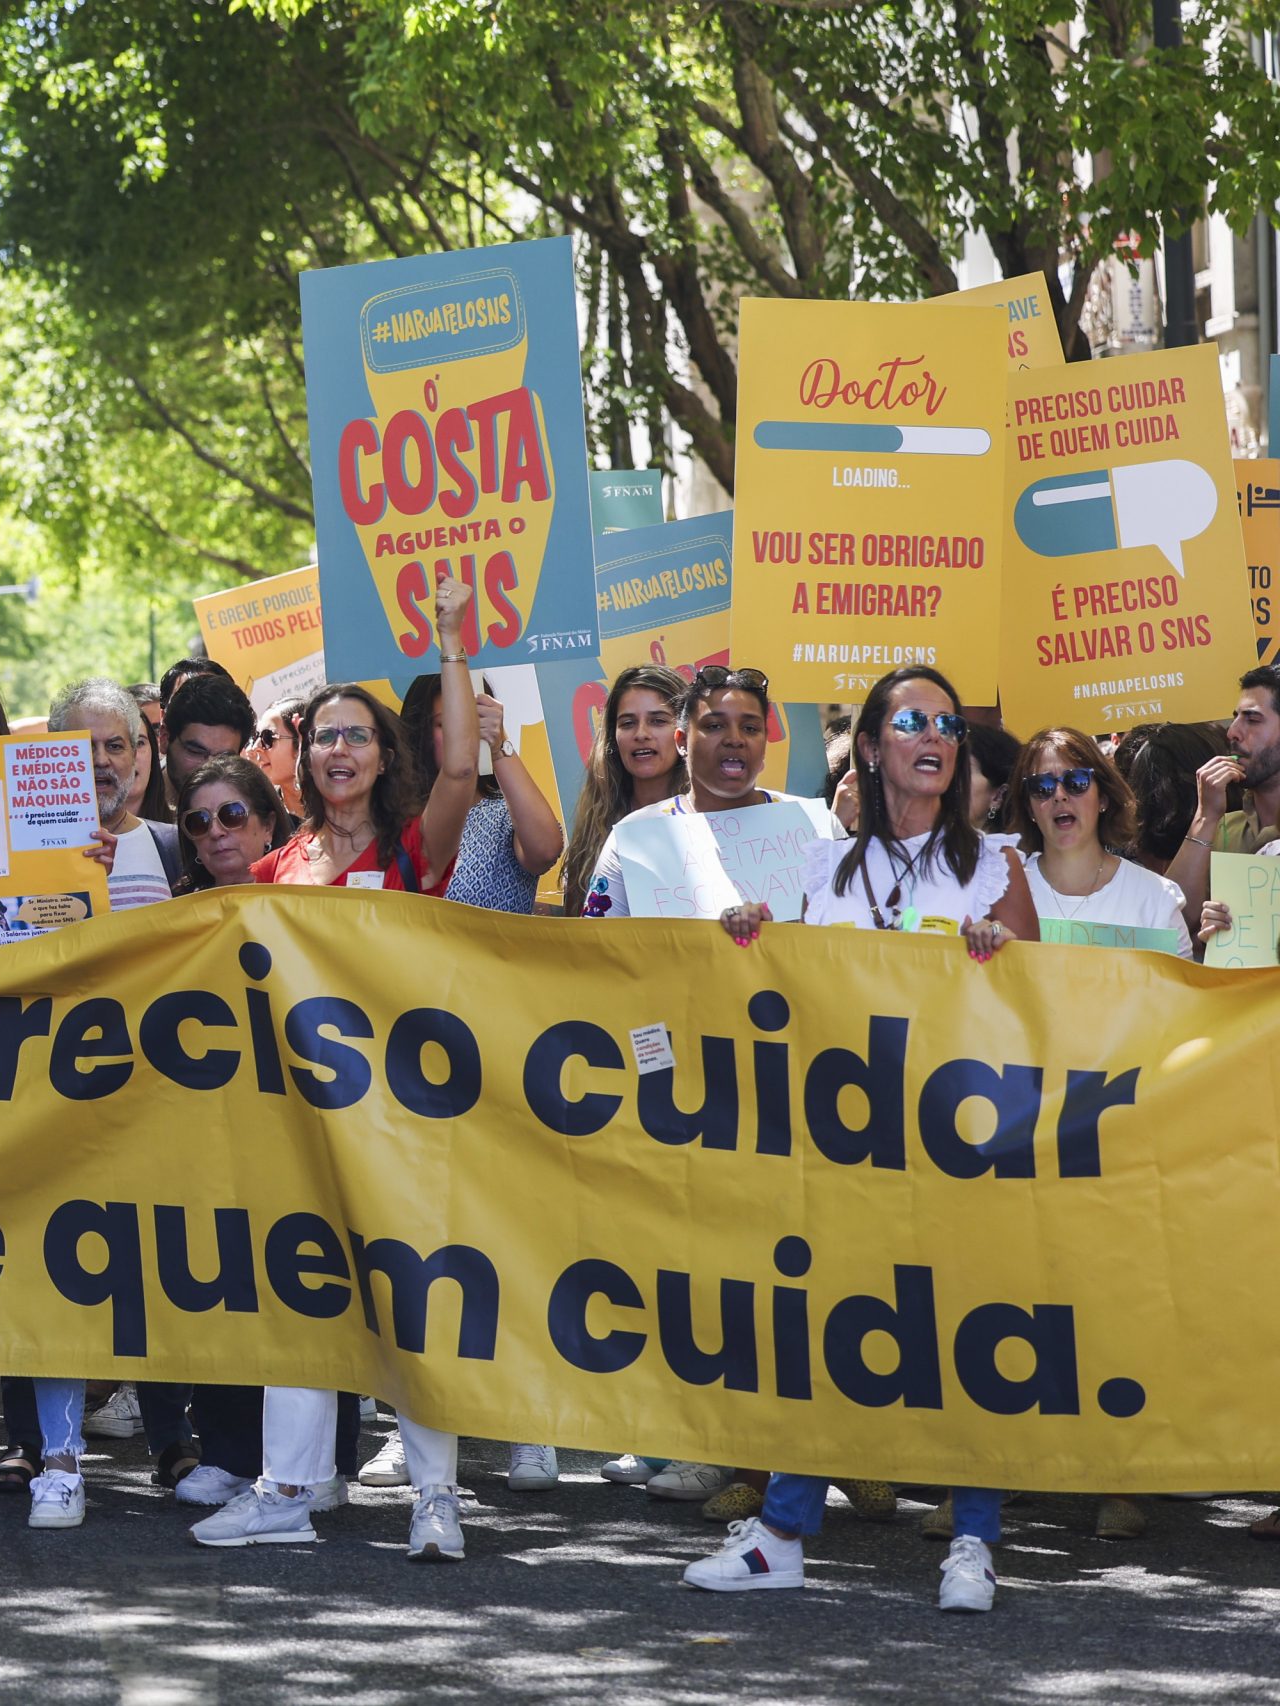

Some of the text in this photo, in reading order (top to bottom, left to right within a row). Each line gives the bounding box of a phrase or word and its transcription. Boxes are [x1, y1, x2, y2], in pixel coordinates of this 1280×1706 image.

[371, 293, 511, 344] #NARUAPELOSNS
[1008, 296, 1042, 323] AVE
[799, 354, 947, 416] Doctor
[1014, 378, 1186, 426] PRECISO CUIDAR
[1017, 414, 1180, 461] DE QUEM CUIDA
[338, 386, 553, 526] COSTA
[614, 487, 653, 497] FNAM
[832, 466, 910, 489] LOADING...
[375, 517, 526, 558] AGUENTA O
[752, 531, 985, 570] VOU SER OBRIGADO
[598, 558, 728, 612] #NARUAPELOSNS
[792, 582, 942, 617] A EMIGRAR?
[1052, 575, 1178, 621] É PRECISO
[206, 584, 315, 630] É GREVE PORQUE
[232, 618, 286, 650] TODOS
[542, 634, 592, 650] FNAM
[1036, 614, 1212, 667] SALVAR O SNS
[792, 643, 937, 665] #NARUAPELOSNS
[279, 664, 312, 685] preciso
[1074, 672, 1184, 699] #NARUAPELOSNS
[1116, 703, 1162, 718] FNAM
[12, 760, 86, 776] E MÉDICAS
[16, 744, 80, 760] MÉDICOS
[17, 775, 80, 791] NÃO SÃO
[12, 792, 91, 808] MÁQUINAS
[30, 811, 55, 820] preciso
[522, 990, 1141, 1179] cuidar
[43, 1199, 500, 1361] quem
[547, 1235, 1147, 1418] cuida.
